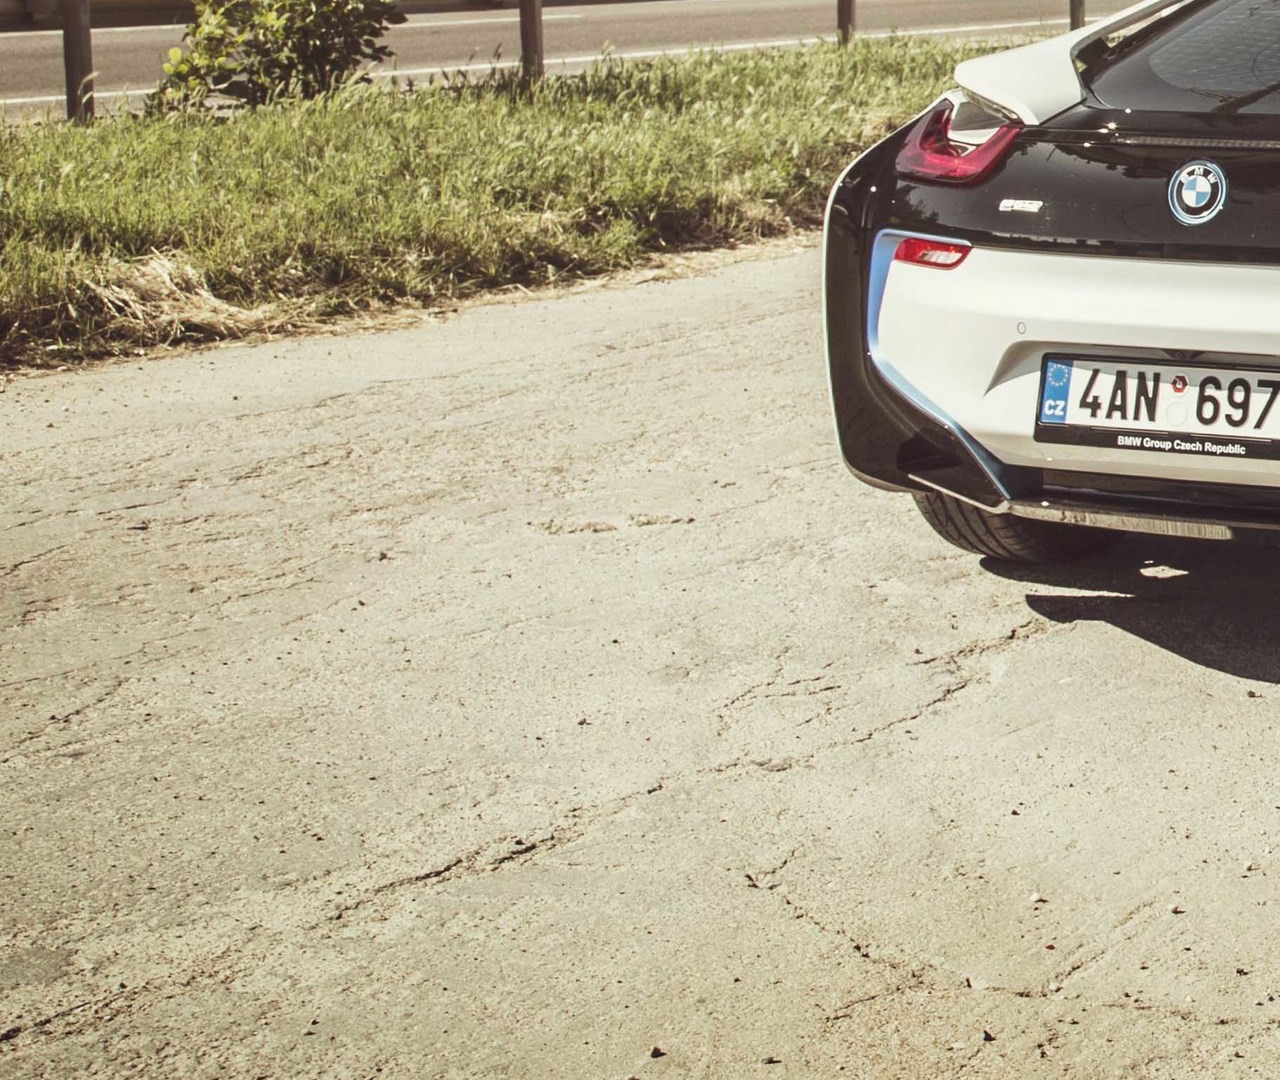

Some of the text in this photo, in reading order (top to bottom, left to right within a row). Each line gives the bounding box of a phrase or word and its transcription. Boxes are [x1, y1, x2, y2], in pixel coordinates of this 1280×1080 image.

[1079, 368, 1161, 422] 4AN
[1044, 399, 1066, 416] CZ
[1117, 435, 1246, 455] BMW Group Czech Republic
